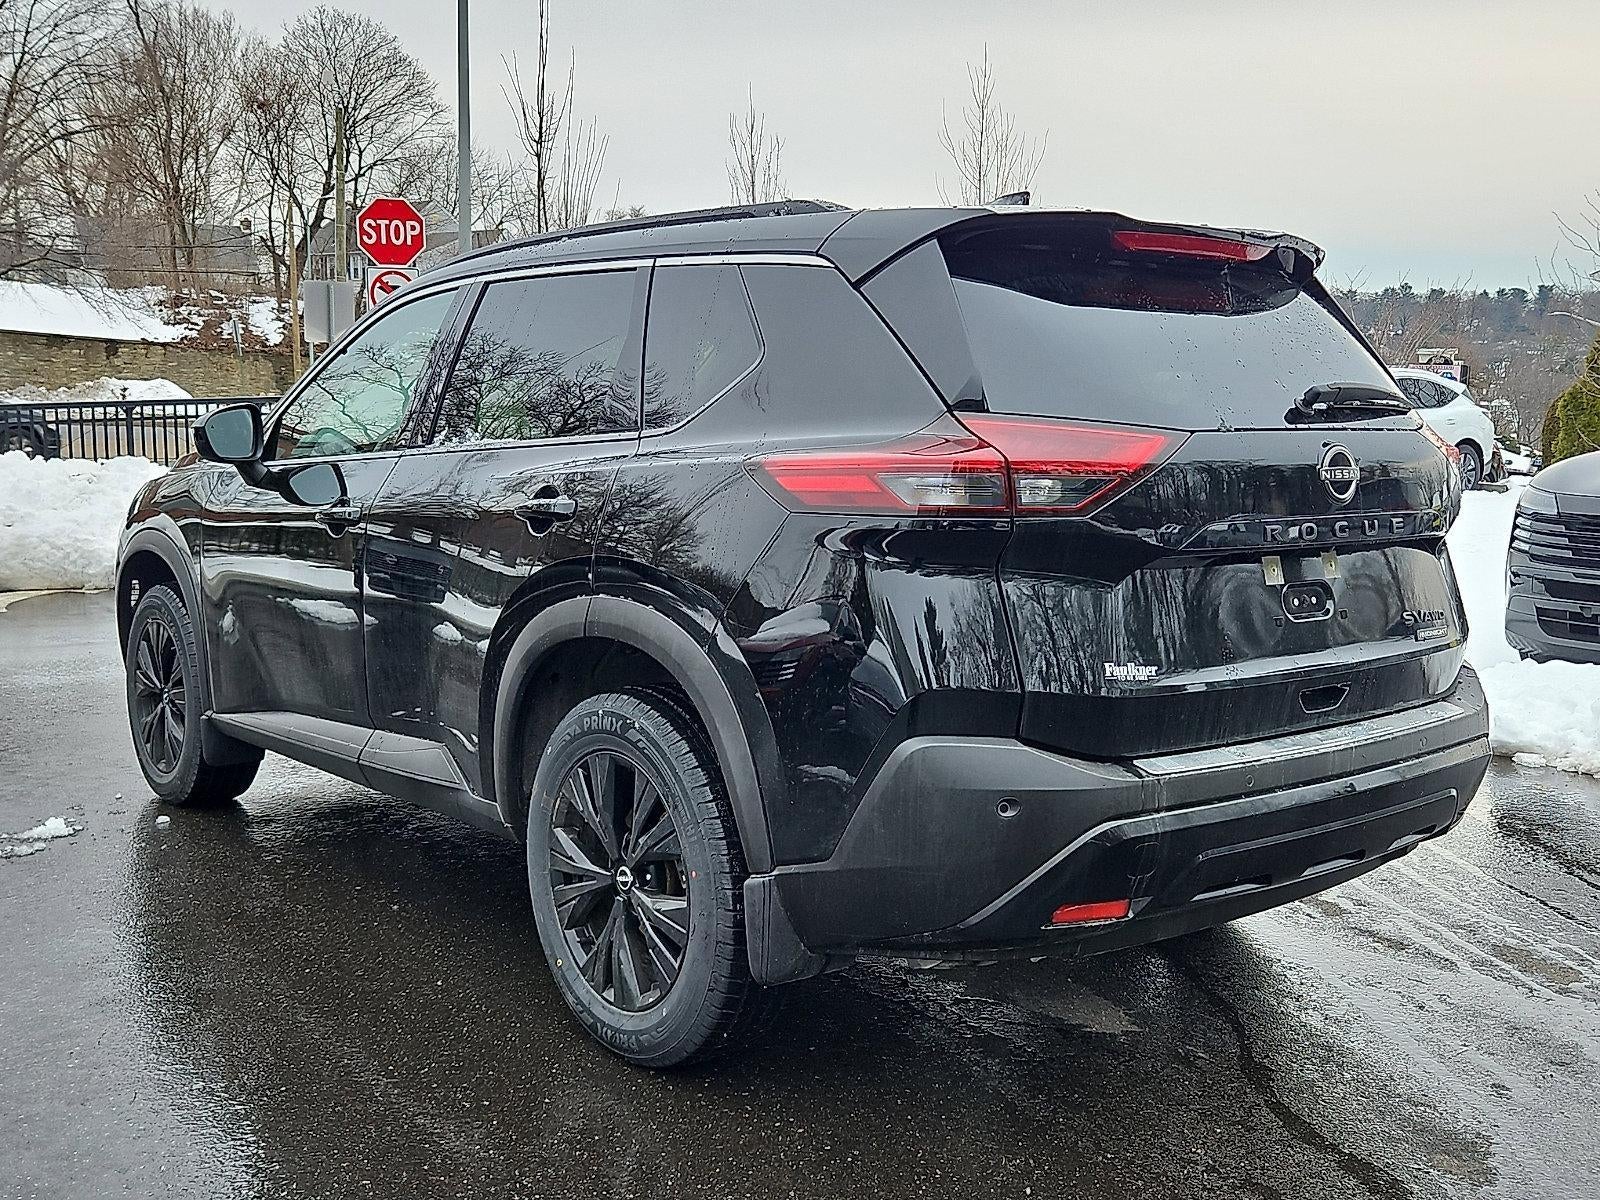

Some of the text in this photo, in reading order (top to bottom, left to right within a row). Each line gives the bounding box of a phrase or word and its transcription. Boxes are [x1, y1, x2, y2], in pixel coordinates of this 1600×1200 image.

[362, 218, 421, 246] STOP
[1321, 469, 1359, 480] NISSAN
[1264, 518, 1405, 543] ROGUE
[1402, 610, 1424, 627] SV
[1103, 662, 1159, 677] Faulkner
[583, 714, 624, 735] PRINX
